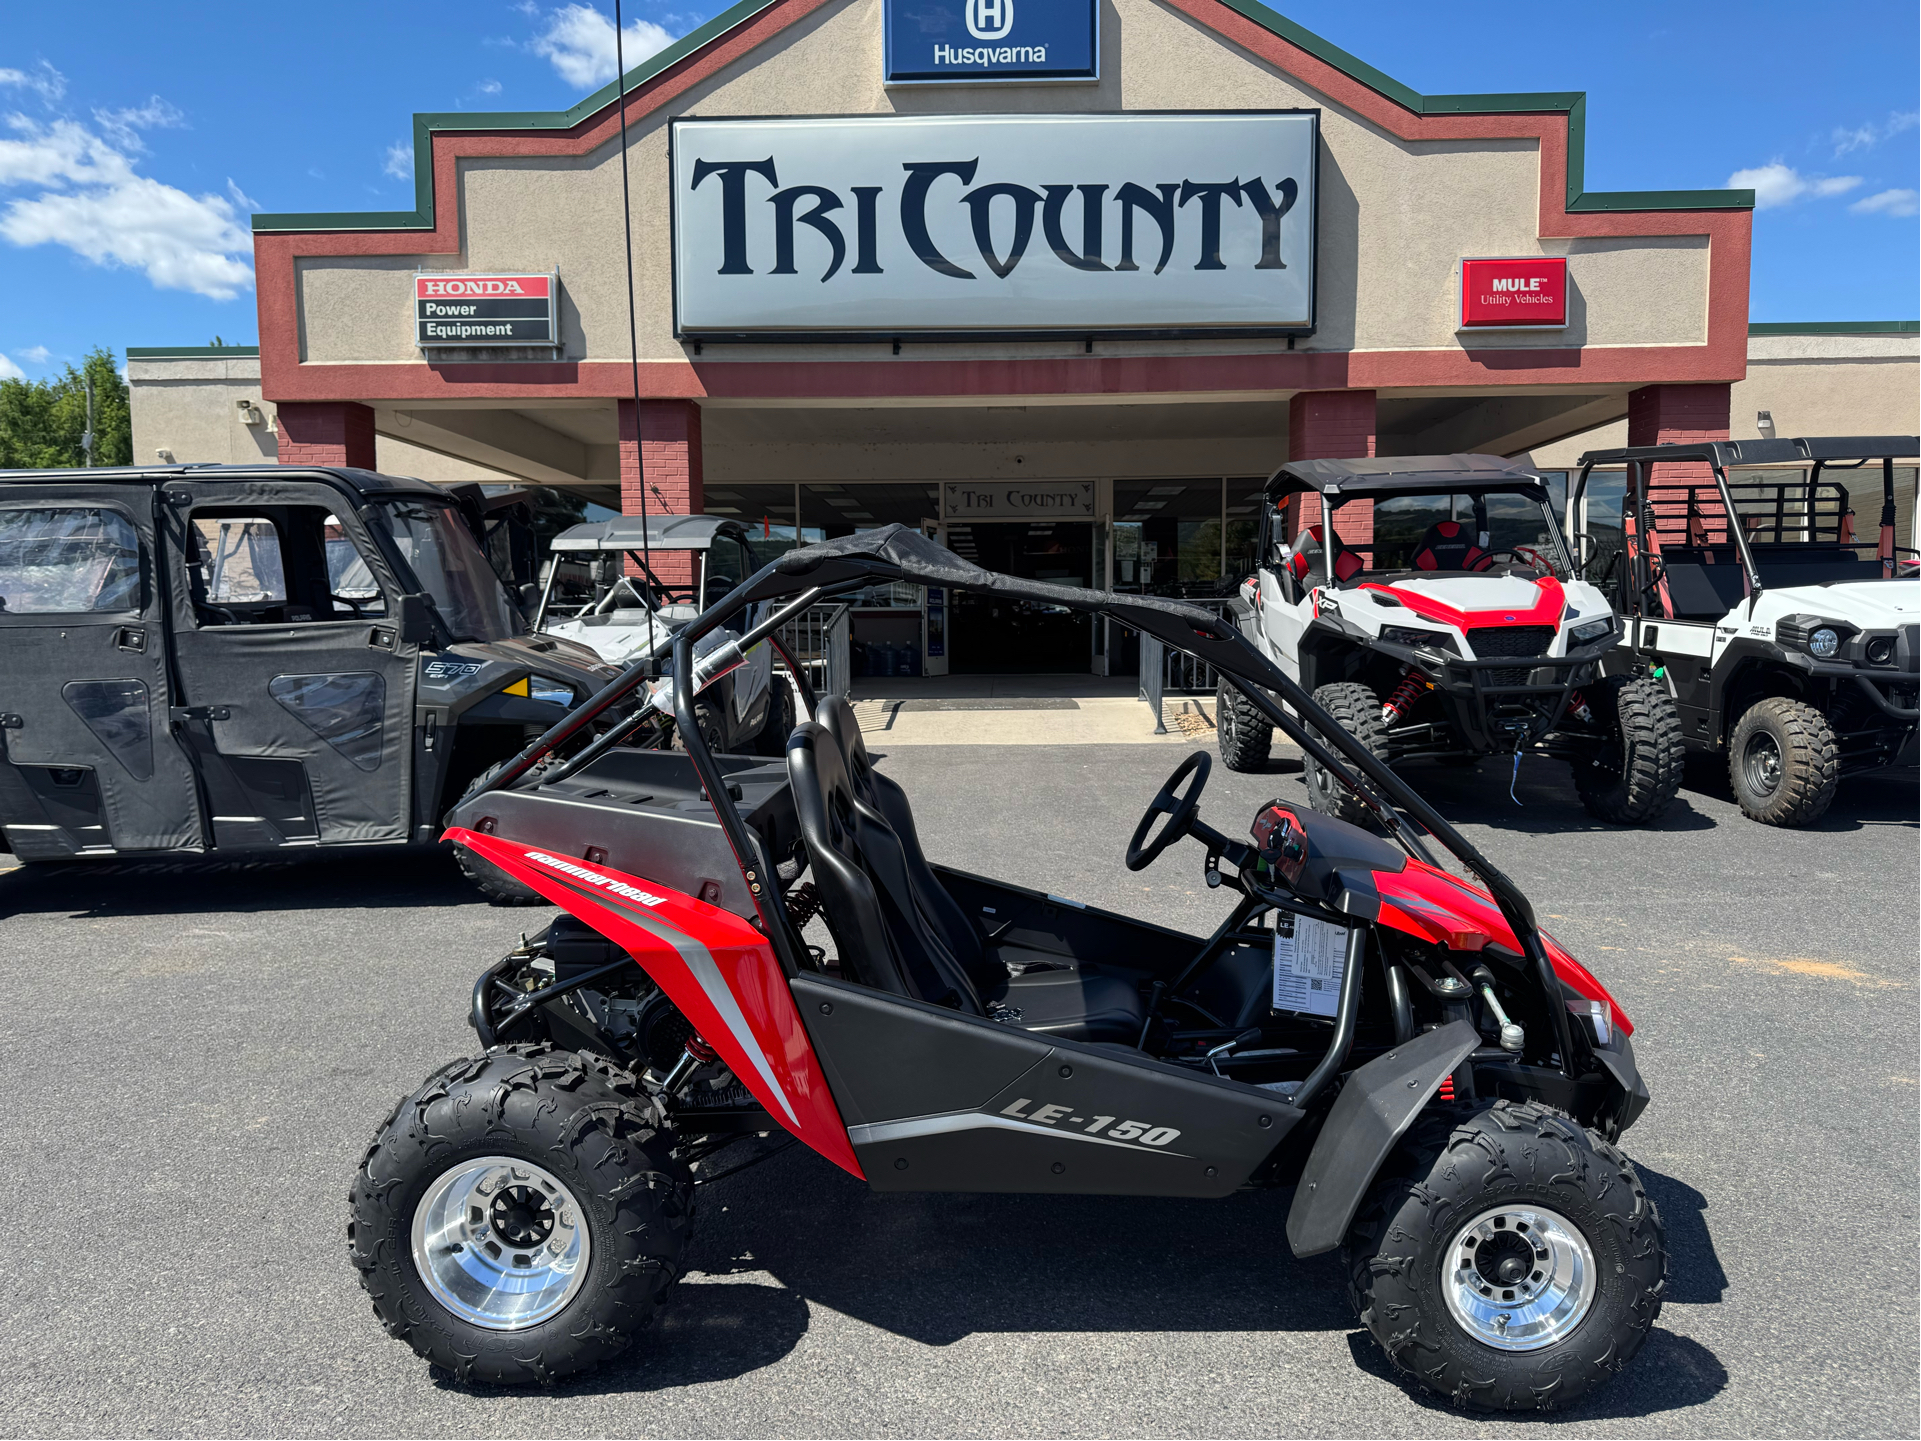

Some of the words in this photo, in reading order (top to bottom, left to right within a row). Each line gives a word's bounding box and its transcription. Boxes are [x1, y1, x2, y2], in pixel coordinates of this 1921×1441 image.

[934, 44, 1046, 67] Husqvarna
[691, 155, 884, 284] TRI
[899, 156, 1298, 280] COUNTY
[425, 281, 525, 295] HONDA
[1481, 294, 1511, 307] Utility
[1514, 293, 1554, 304] Vehicles
[425, 302, 477, 316] Power
[426, 322, 513, 338] Equipment
[425, 661, 482, 676] 570
[1000, 1098, 1181, 1147] LE-150
